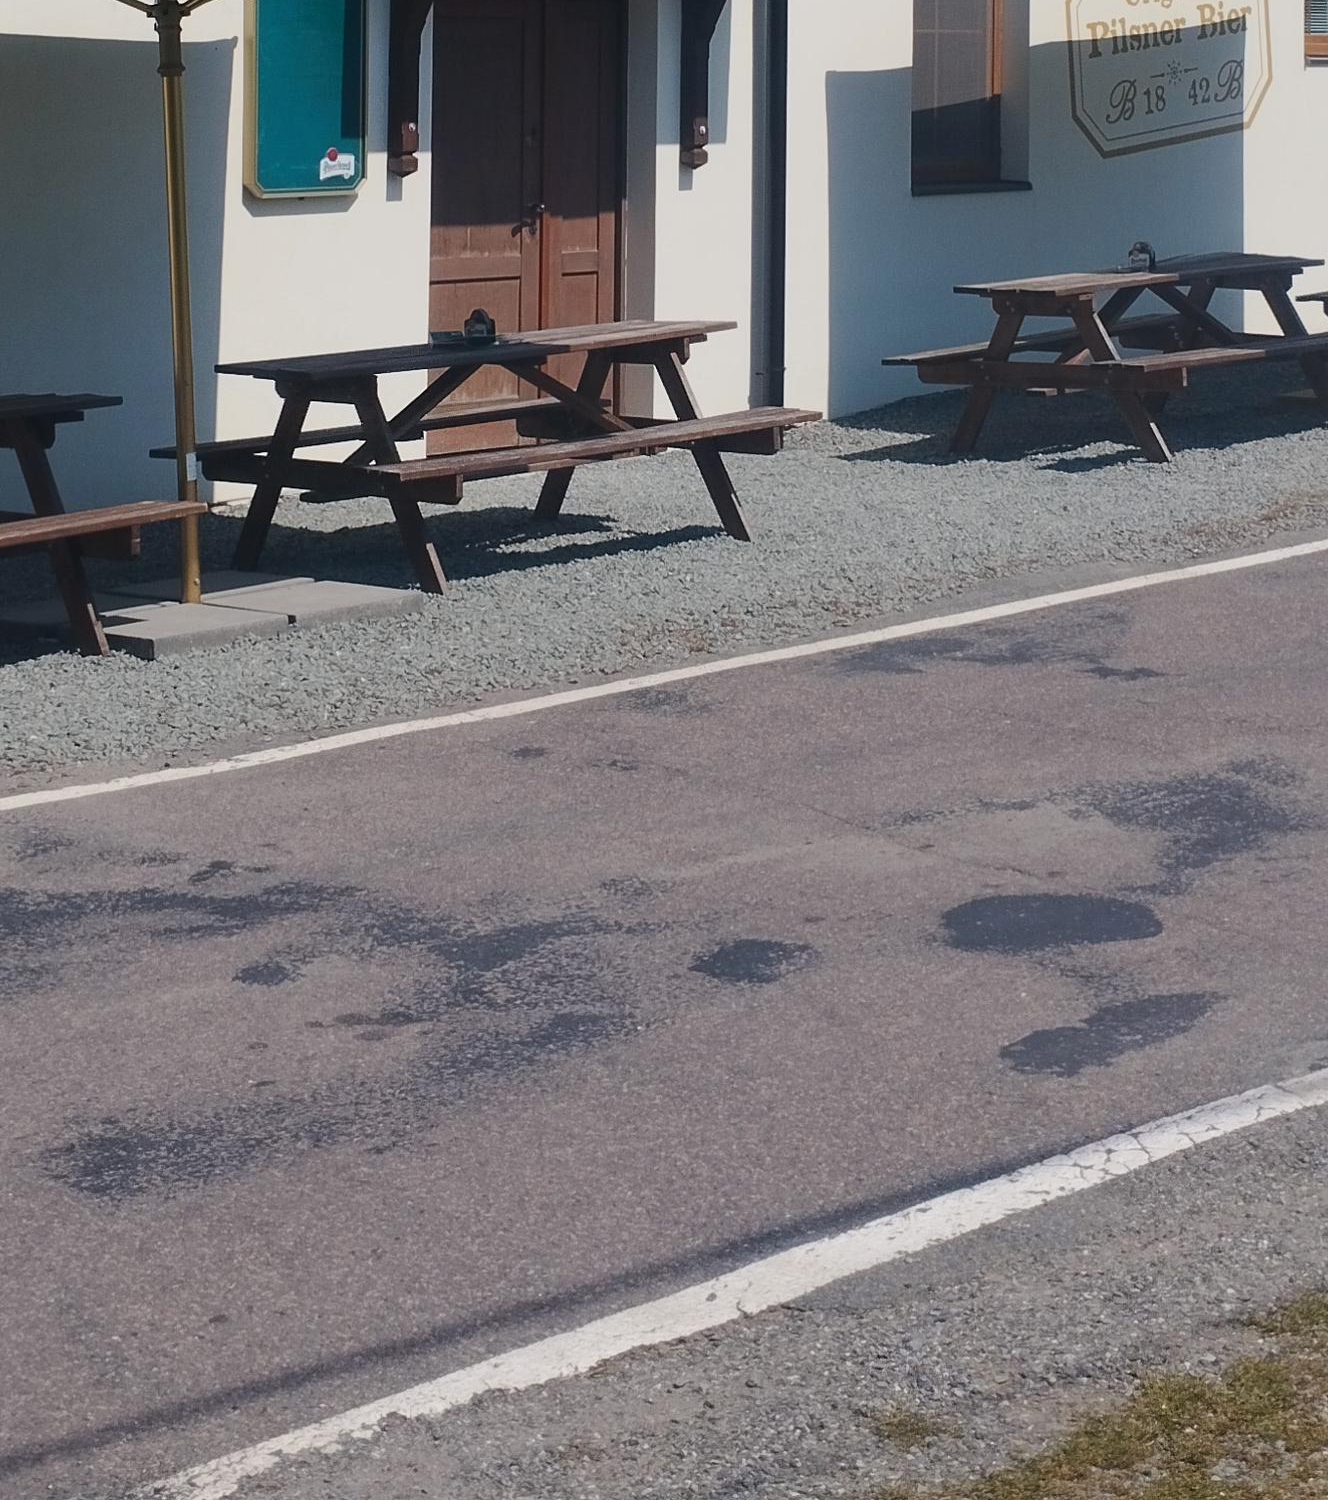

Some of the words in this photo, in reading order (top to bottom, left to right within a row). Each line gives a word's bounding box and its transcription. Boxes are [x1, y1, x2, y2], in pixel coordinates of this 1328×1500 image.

[1087, 15, 1186, 59] Pilsner
[1196, 1, 1252, 41] Bier
[1106, 79, 1137, 125] B
[1143, 85, 1166, 115] 18
[1188, 77, 1211, 106] 42
